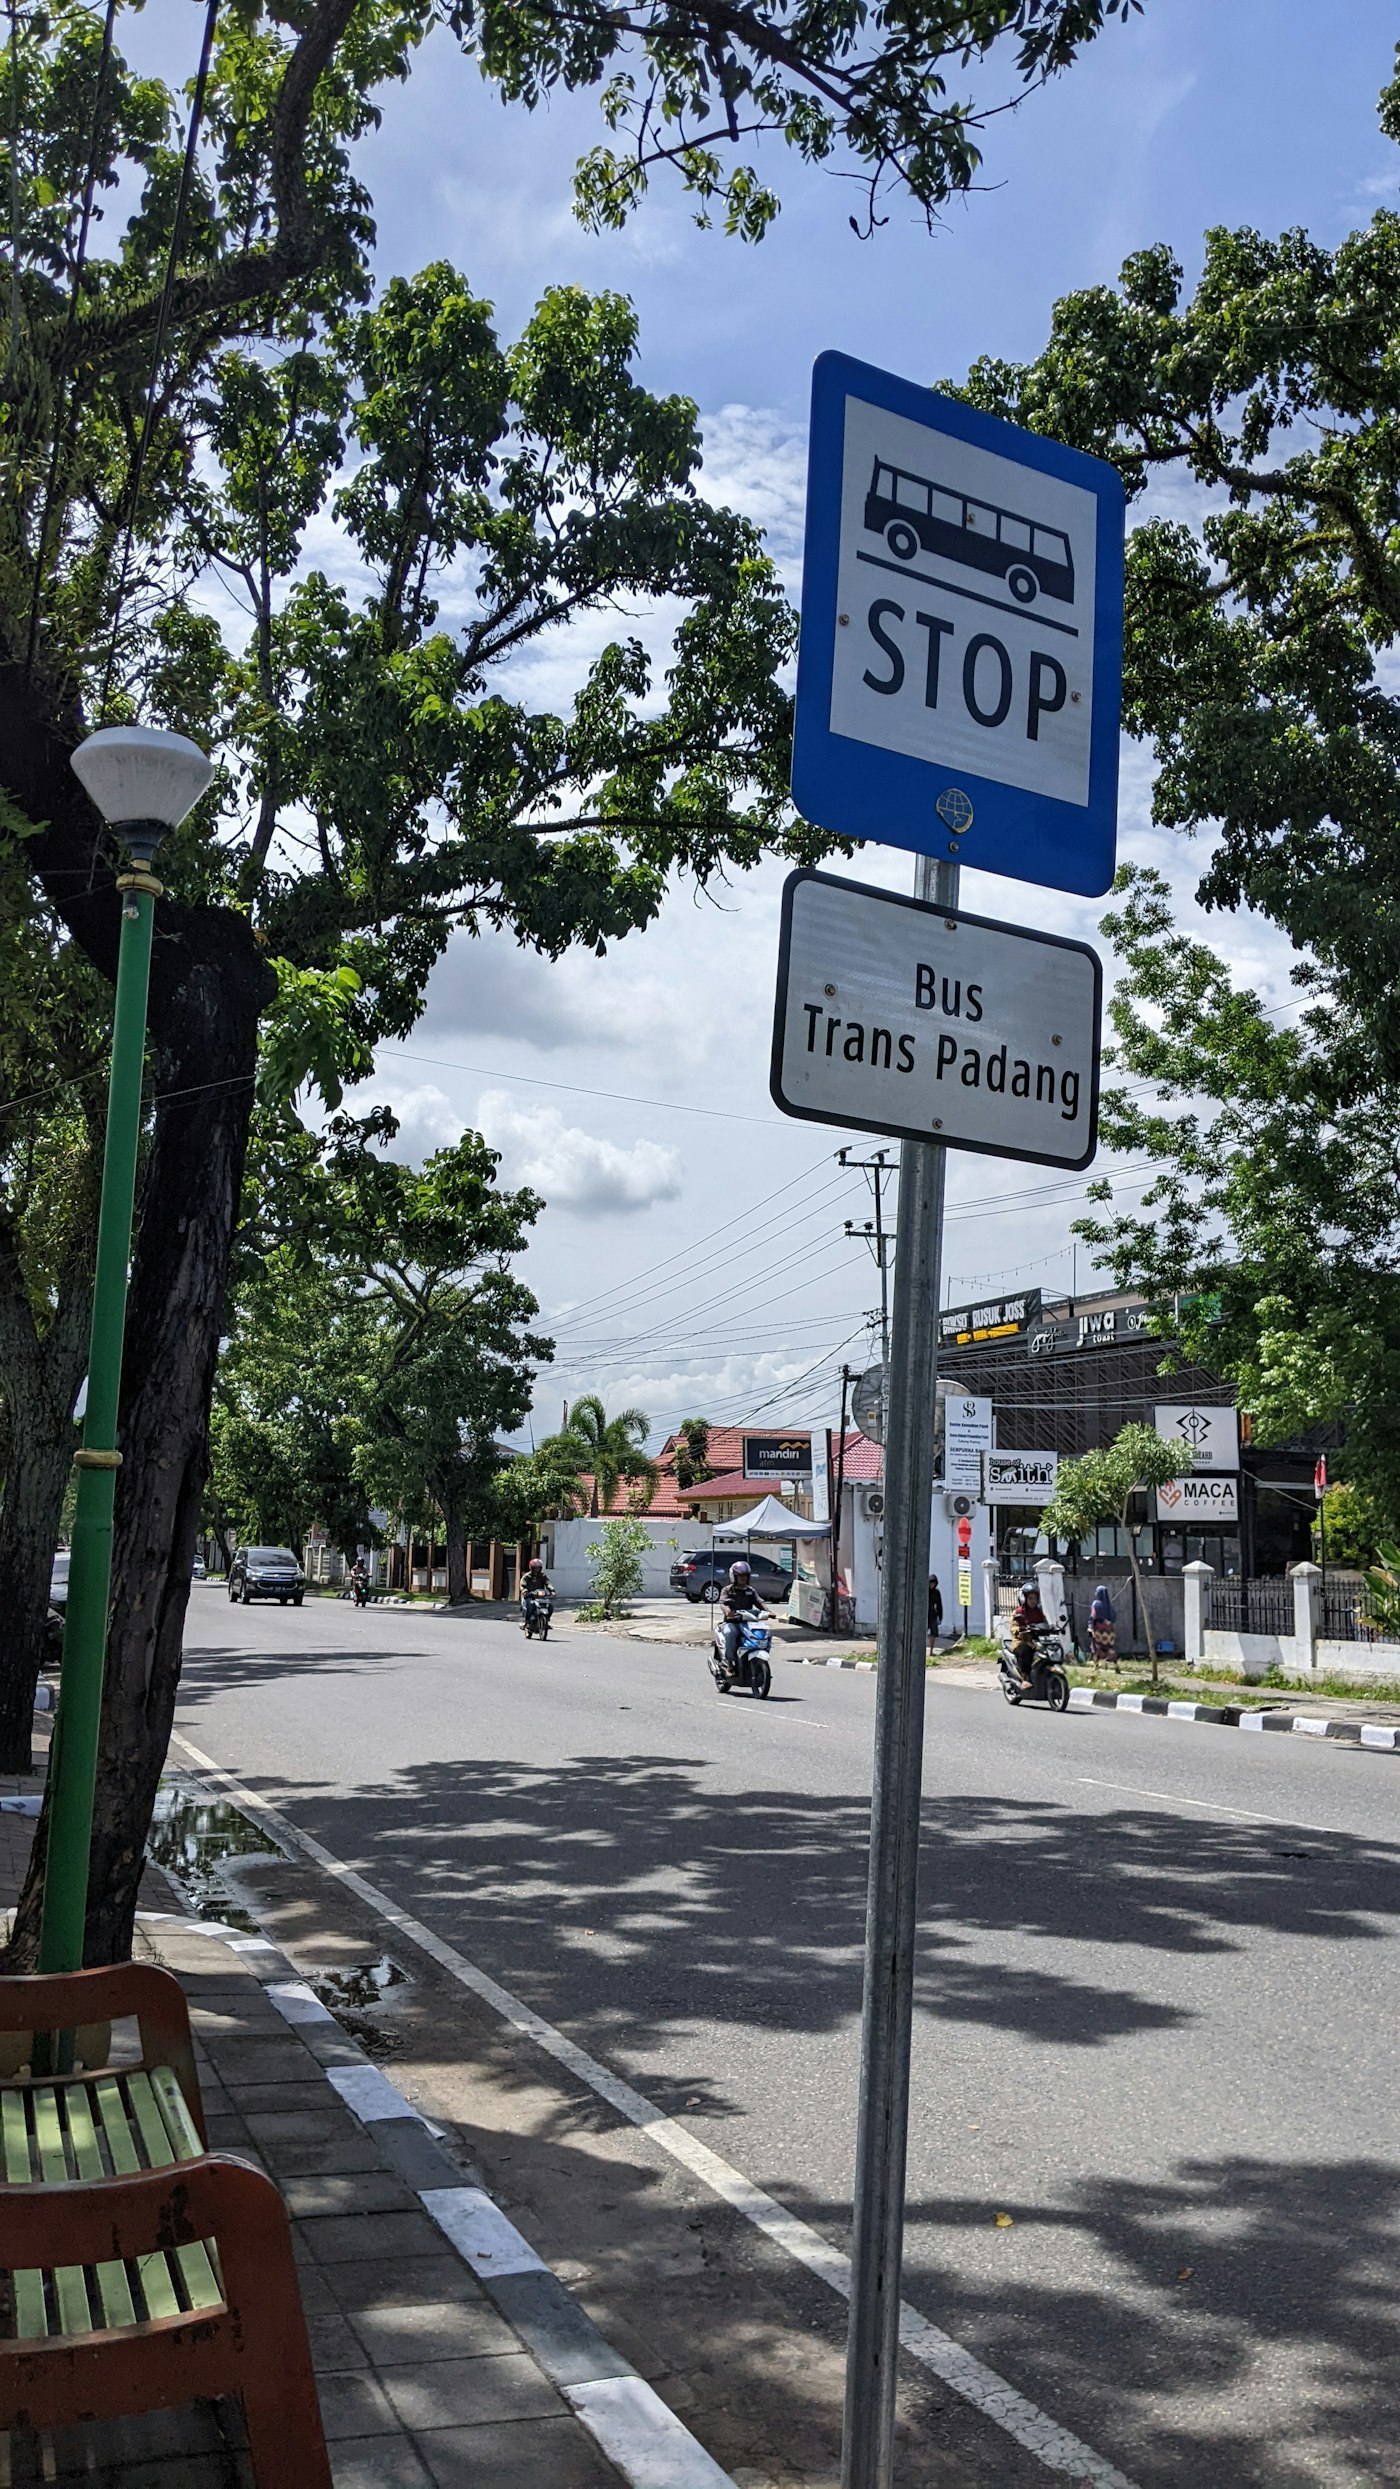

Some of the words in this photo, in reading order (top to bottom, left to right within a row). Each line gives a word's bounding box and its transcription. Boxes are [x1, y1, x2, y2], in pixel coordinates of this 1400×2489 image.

[862, 598, 1067, 741] STOP
[915, 963, 984, 1022] Bus
[803, 1003, 915, 1074] Trans
[936, 1034, 1080, 1121] Padang
[942, 1312, 969, 1335] BAKSO
[972, 1305, 1002, 1329] RUSUK
[1002, 1299, 1026, 1322] JOSS
[759, 1448, 800, 1459] mandiri
[989, 1457, 1011, 1466] house
[1012, 1458, 1021, 1466] of
[1184, 1483, 1234, 1498] MACA
[1184, 1499, 1236, 1507] COFFEE
